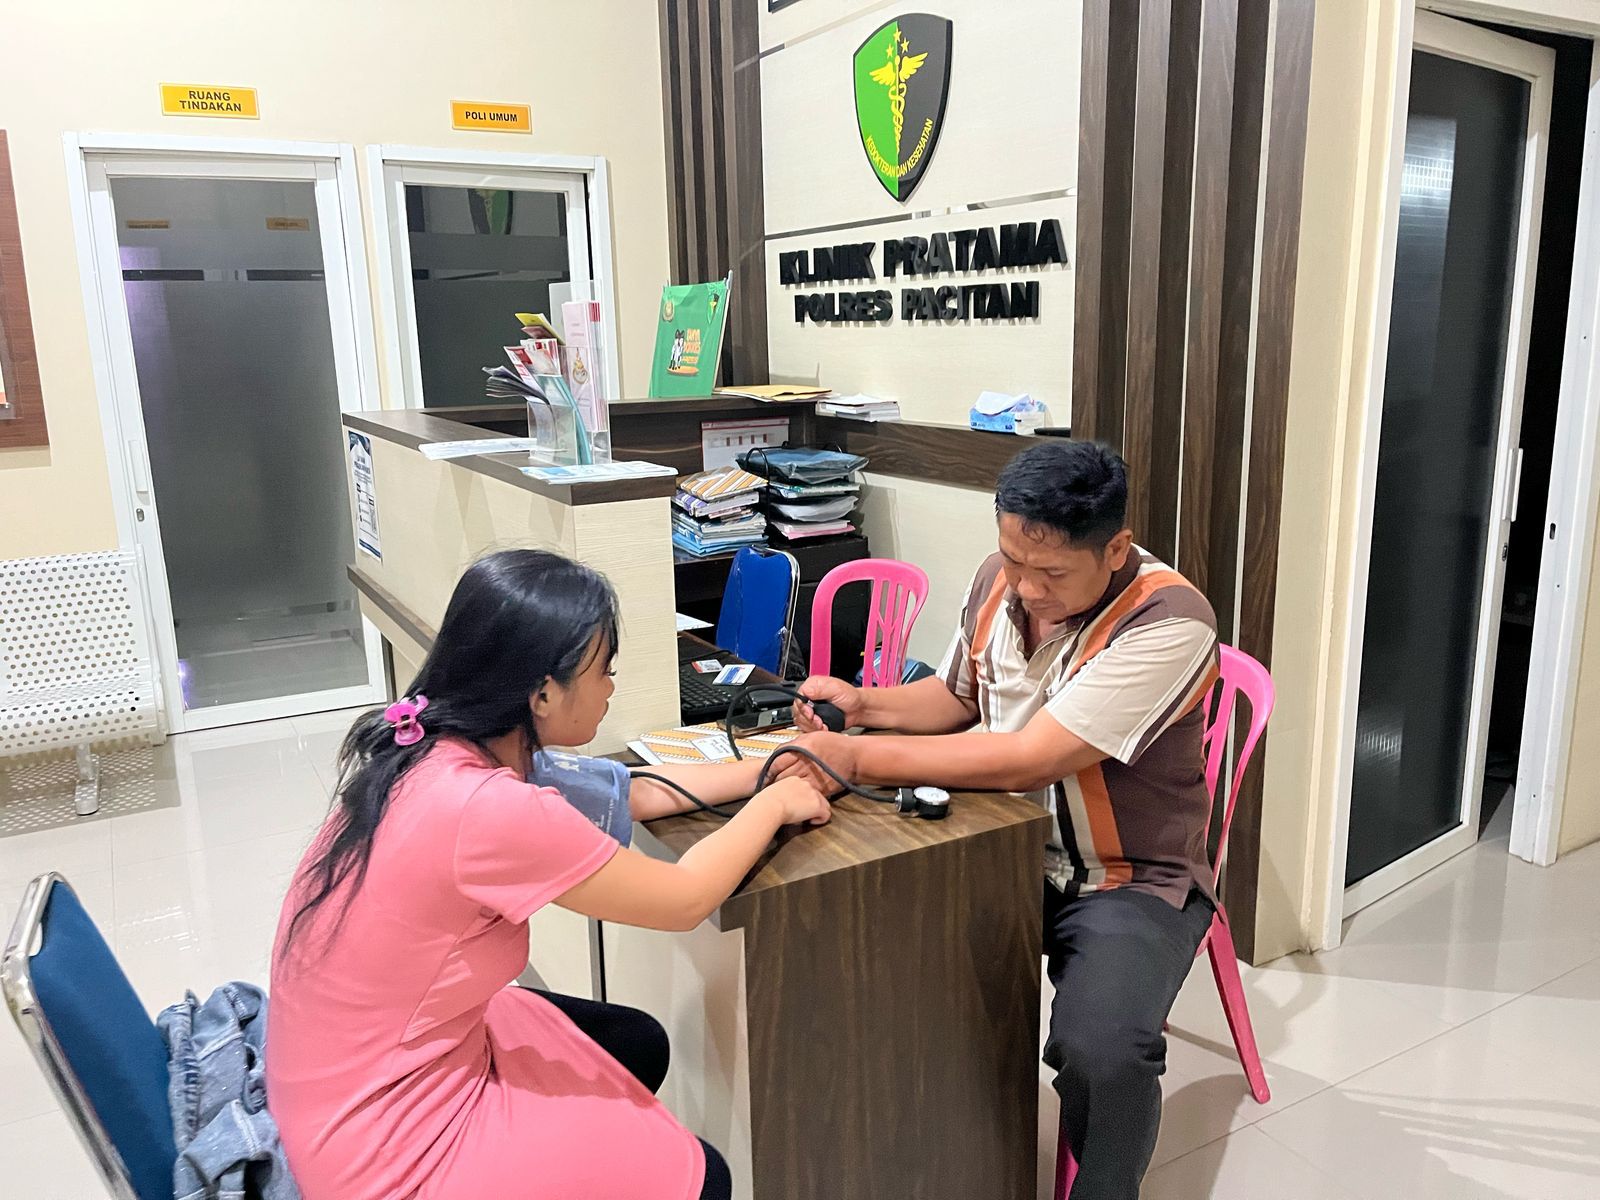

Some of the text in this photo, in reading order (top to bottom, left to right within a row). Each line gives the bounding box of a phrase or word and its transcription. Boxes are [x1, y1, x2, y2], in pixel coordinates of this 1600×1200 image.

[179, 100, 242, 112] TINDAKAN
[188, 90, 231, 101] RUANG
[465, 111, 518, 122] POLI UMUM
[906, 118, 933, 172] KESEHATAN
[779, 219, 1068, 285] KLINIK PRATAMA
[794, 281, 1040, 323] POLRES PACITAN
